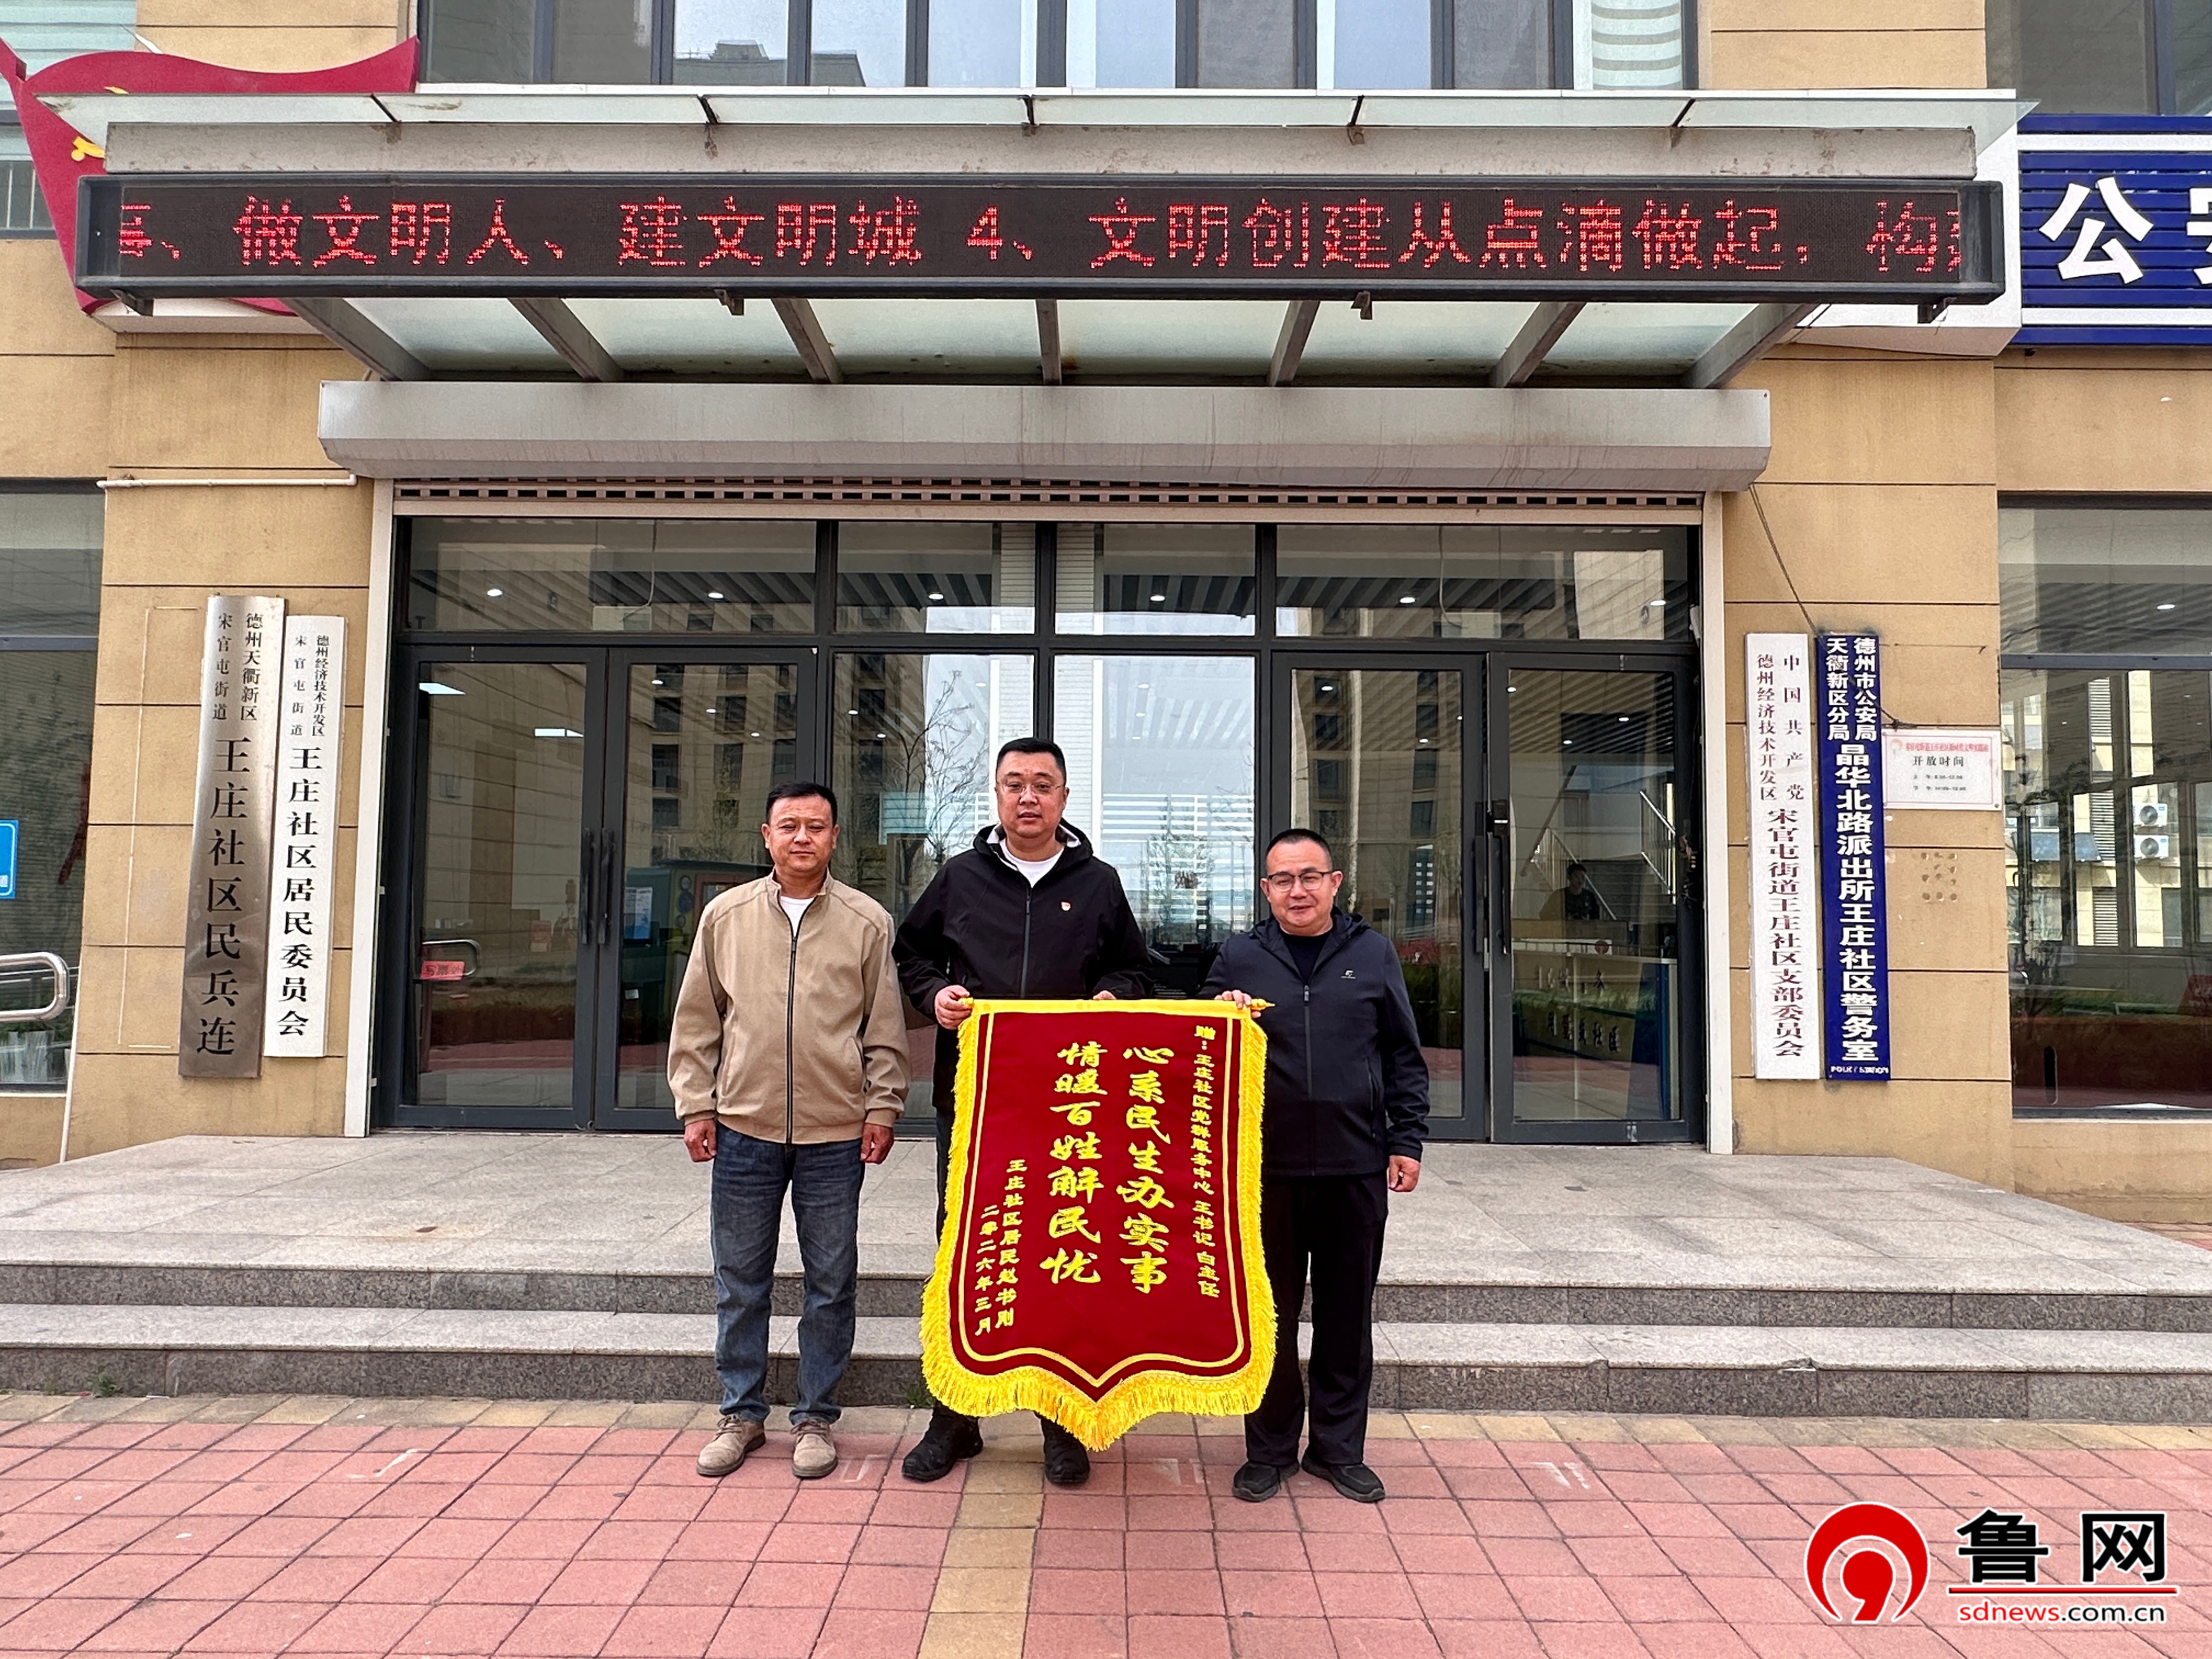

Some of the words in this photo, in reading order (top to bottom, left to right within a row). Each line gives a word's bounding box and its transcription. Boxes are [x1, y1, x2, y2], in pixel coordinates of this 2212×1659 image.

[967, 196, 1962, 272] 4、文明创建从点滴做起，构
[2039, 177, 2212, 284] 公
[213, 612, 233, 720] 宋官屯街道
[241, 613, 263, 721] 德州天衢新区
[290, 635, 307, 736] 宋官屯街道
[312, 635, 330, 736] 德州经济技术开发区
[1757, 654, 1777, 800] 德州经济技术开发区
[1784, 654, 1804, 800] 中国共产党
[1826, 637, 1850, 741] 天衢新区分局
[1853, 637, 1878, 742] 德州市公安局
[1912, 755, 1964, 767] 开放时间
[196, 737, 252, 1055] 王庄社区民兵连
[276, 747, 323, 1036] 王庄社区居民委员会
[1767, 808, 1804, 1057] 宋官屯街道王庄社区支部委员会
[1835, 744, 1879, 1061] 晶华北路派出所王庄社区警务室
[1039, 1041, 1108, 1284] 情暖百姓解民忧
[1116, 1046, 1175, 1294] 心系民生办实事
[974, 1204, 1000, 1336] 二零二六年三月
[995, 1159, 1028, 1329] 王庄社区居民赵书刚
